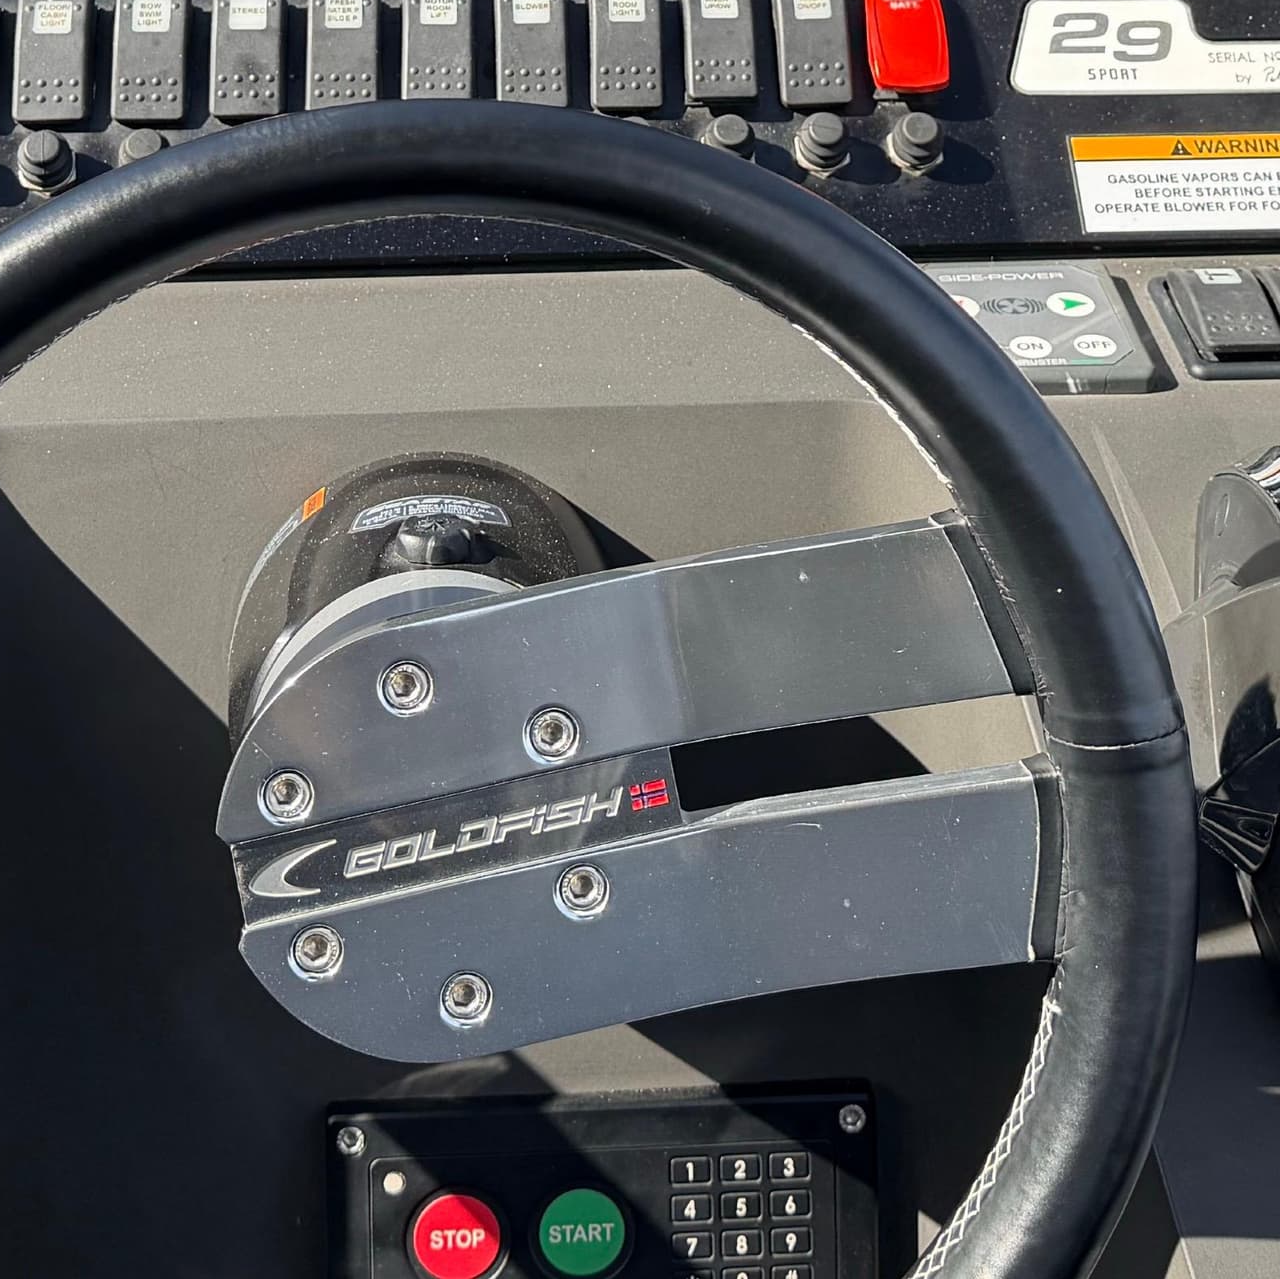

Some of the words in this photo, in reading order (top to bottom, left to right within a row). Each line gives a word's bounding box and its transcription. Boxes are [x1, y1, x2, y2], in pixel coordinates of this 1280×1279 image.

[140, 2, 162, 10] BOW
[139, 10, 162, 18] SWIM
[611, 9, 641, 17] LIGHTS
[40, 19, 66, 27] LIGHT
[137, 18, 162, 26] LIGHT
[1208, 51, 1256, 63] SERIAL
[1087, 67, 1139, 81] SPORT
[1235, 72, 1252, 84] by
[1107, 173, 1180, 184] GASOLINE
[1181, 172, 1240, 183] VAPORS
[1242, 171, 1273, 182] CAN
[1134, 187, 1193, 199] BEFORE
[1194, 186, 1266, 198] STARTING
[1094, 202, 1161, 214] OPERATE
[1163, 201, 1227, 212] BLOWER
[1228, 201, 1258, 211] FOR
[938, 272, 1065, 283] SIDE-POWER
[1016, 342, 1045, 352] ON
[1076, 340, 1113, 350] OFF
[342, 785, 624, 880] GOLDFISH
[685, 1162, 695, 1182] 1
[733, 1159, 747, 1180] 2
[783, 1157, 796, 1178] 3
[683, 1199, 697, 1220] 4
[735, 1197, 748, 1218] 5
[784, 1194, 797, 1216] 6
[547, 1222, 615, 1244] START
[428, 1230, 486, 1250] STOP
[736, 1234, 749, 1255] 8
[785, 1232, 798, 1253] 9
[686, 1237, 699, 1258] 7
